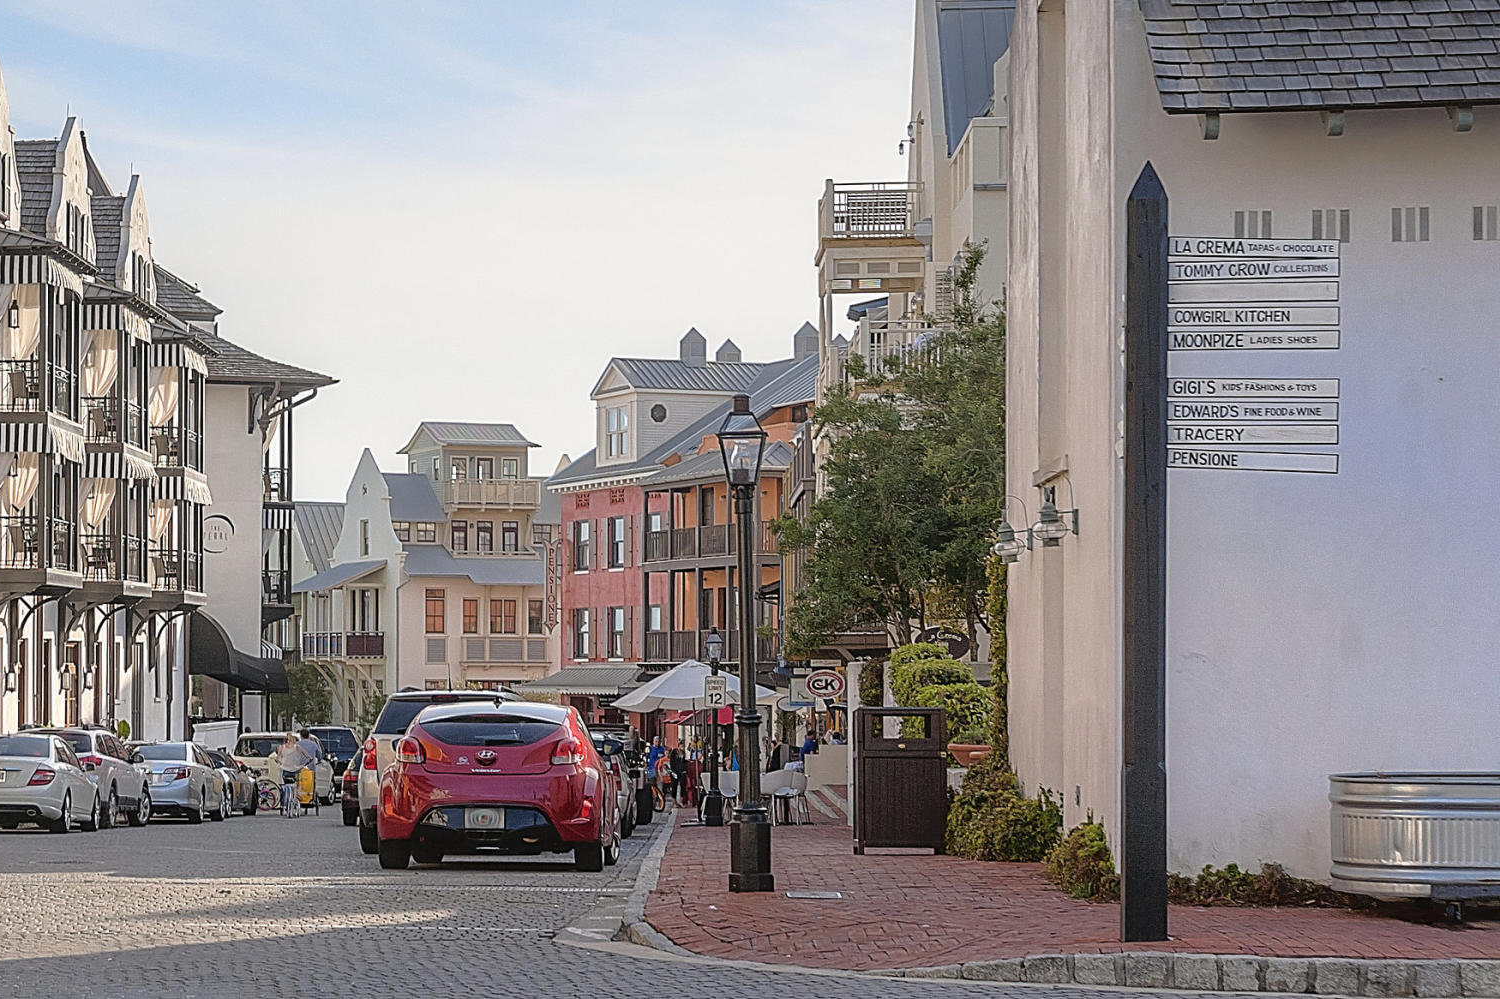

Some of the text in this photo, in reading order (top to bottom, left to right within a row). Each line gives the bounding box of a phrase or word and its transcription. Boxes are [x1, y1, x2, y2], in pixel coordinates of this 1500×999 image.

[1174, 240, 1192, 255] LA
[1196, 240, 1246, 255] CREMA
[1247, 243, 1275, 252] TAPAS
[1282, 244, 1335, 253] CHOCOLATE
[1175, 262, 1329, 278] TOMMY CROW COLLECTIONS
[1174, 310, 1291, 324] COWGIRL KITCHEN
[1173, 333, 1318, 349] MOONPIZE LADIES SHOES
[1173, 380, 1216, 395] GIGI'S
[1244, 383, 1286, 392] FASHIONS
[1295, 383, 1317, 392] TOYS
[1173, 405, 1239, 419] EDWARD'S
[1243, 407, 1263, 416] FINE
[1264, 407, 1288, 416] FOOD
[1296, 407, 1322, 416] WINE
[1174, 427, 1245, 442] TRACERY
[1170, 451, 1239, 467] PENSIONE
[548, 547, 556, 623] PENSIONE
[708, 692, 723, 705] 12
